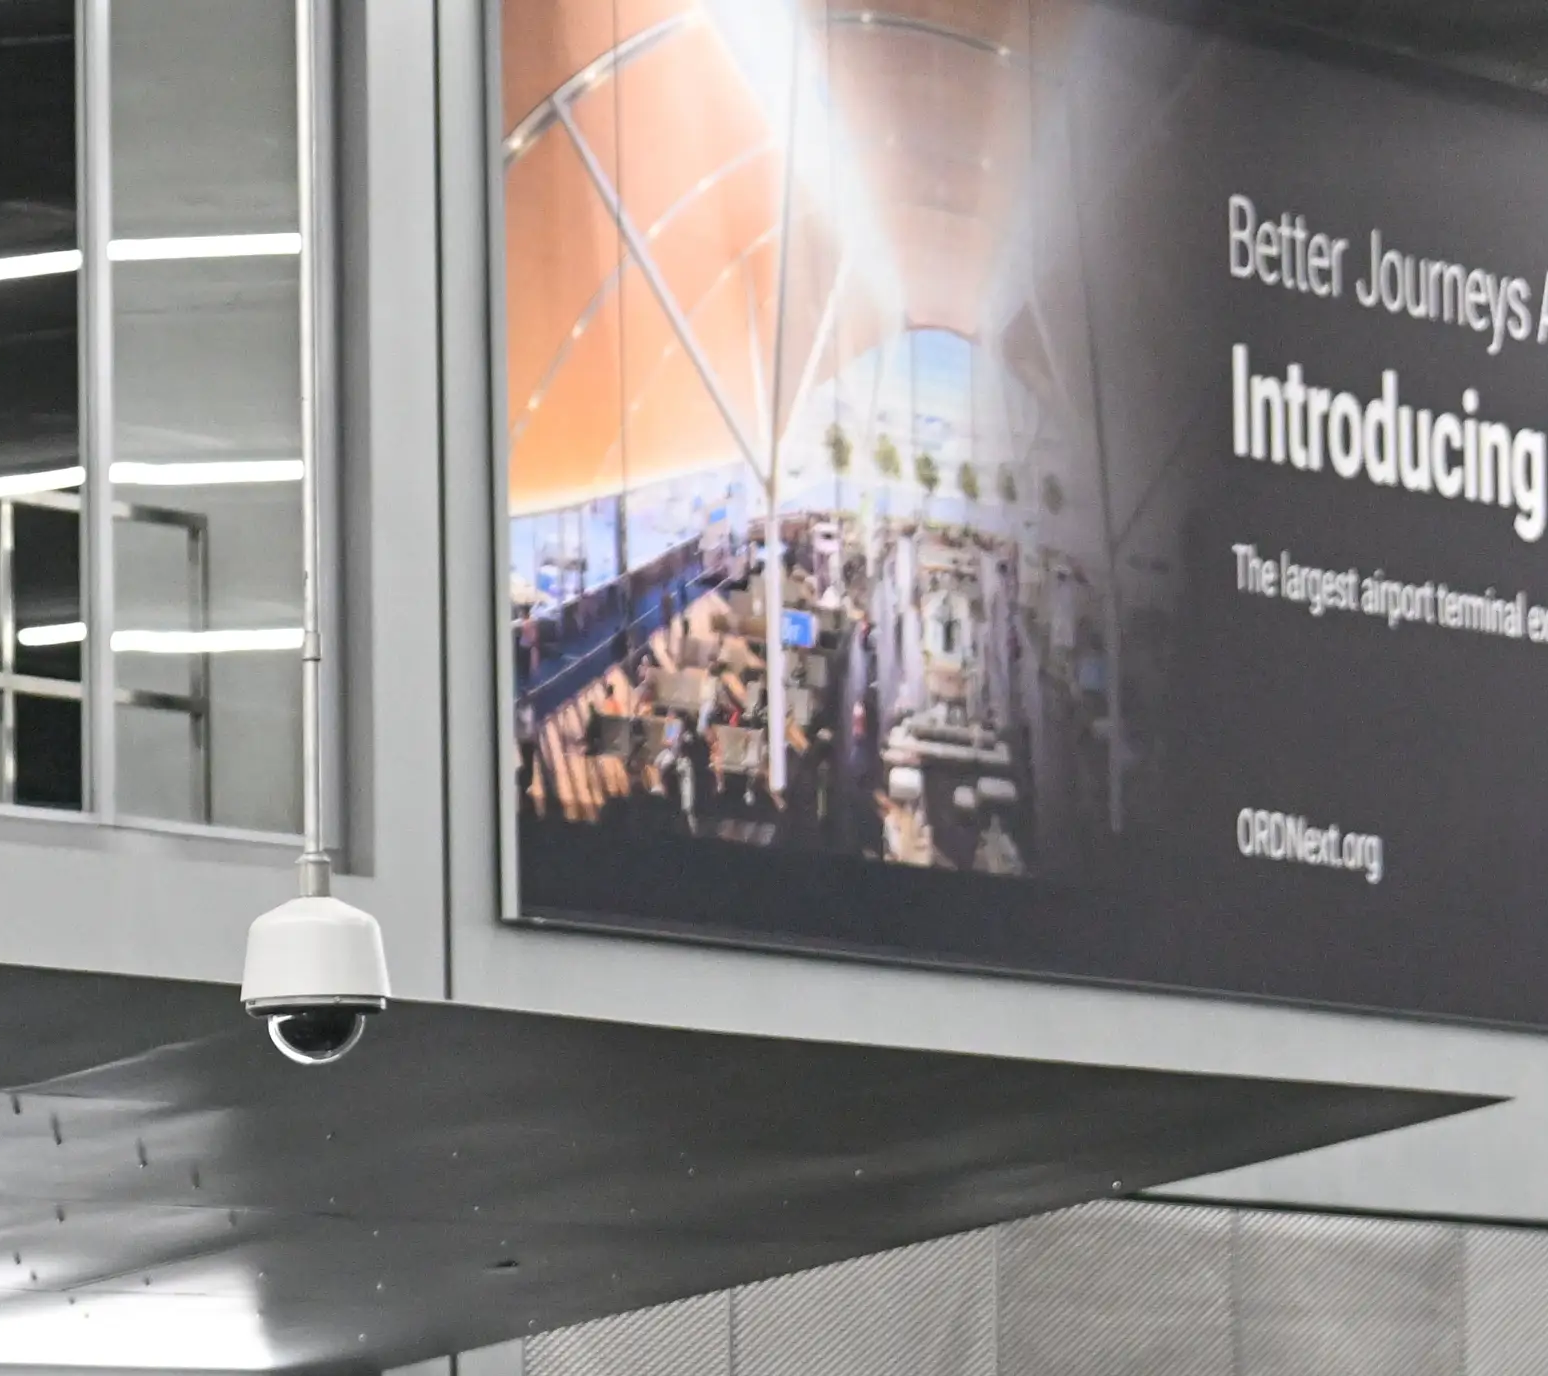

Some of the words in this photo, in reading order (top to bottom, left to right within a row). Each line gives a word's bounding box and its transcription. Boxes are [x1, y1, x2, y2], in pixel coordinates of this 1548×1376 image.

[1228, 192, 1350, 298] Better
[1356, 227, 1532, 356] Journeys
[1231, 342, 1548, 543] Introducing
[1232, 542, 1278, 597] The
[1279, 550, 1358, 617] largest
[1360, 568, 1436, 630] airport
[1437, 582, 1527, 642] terminal
[1236, 807, 1383, 884] ORDNext.org
